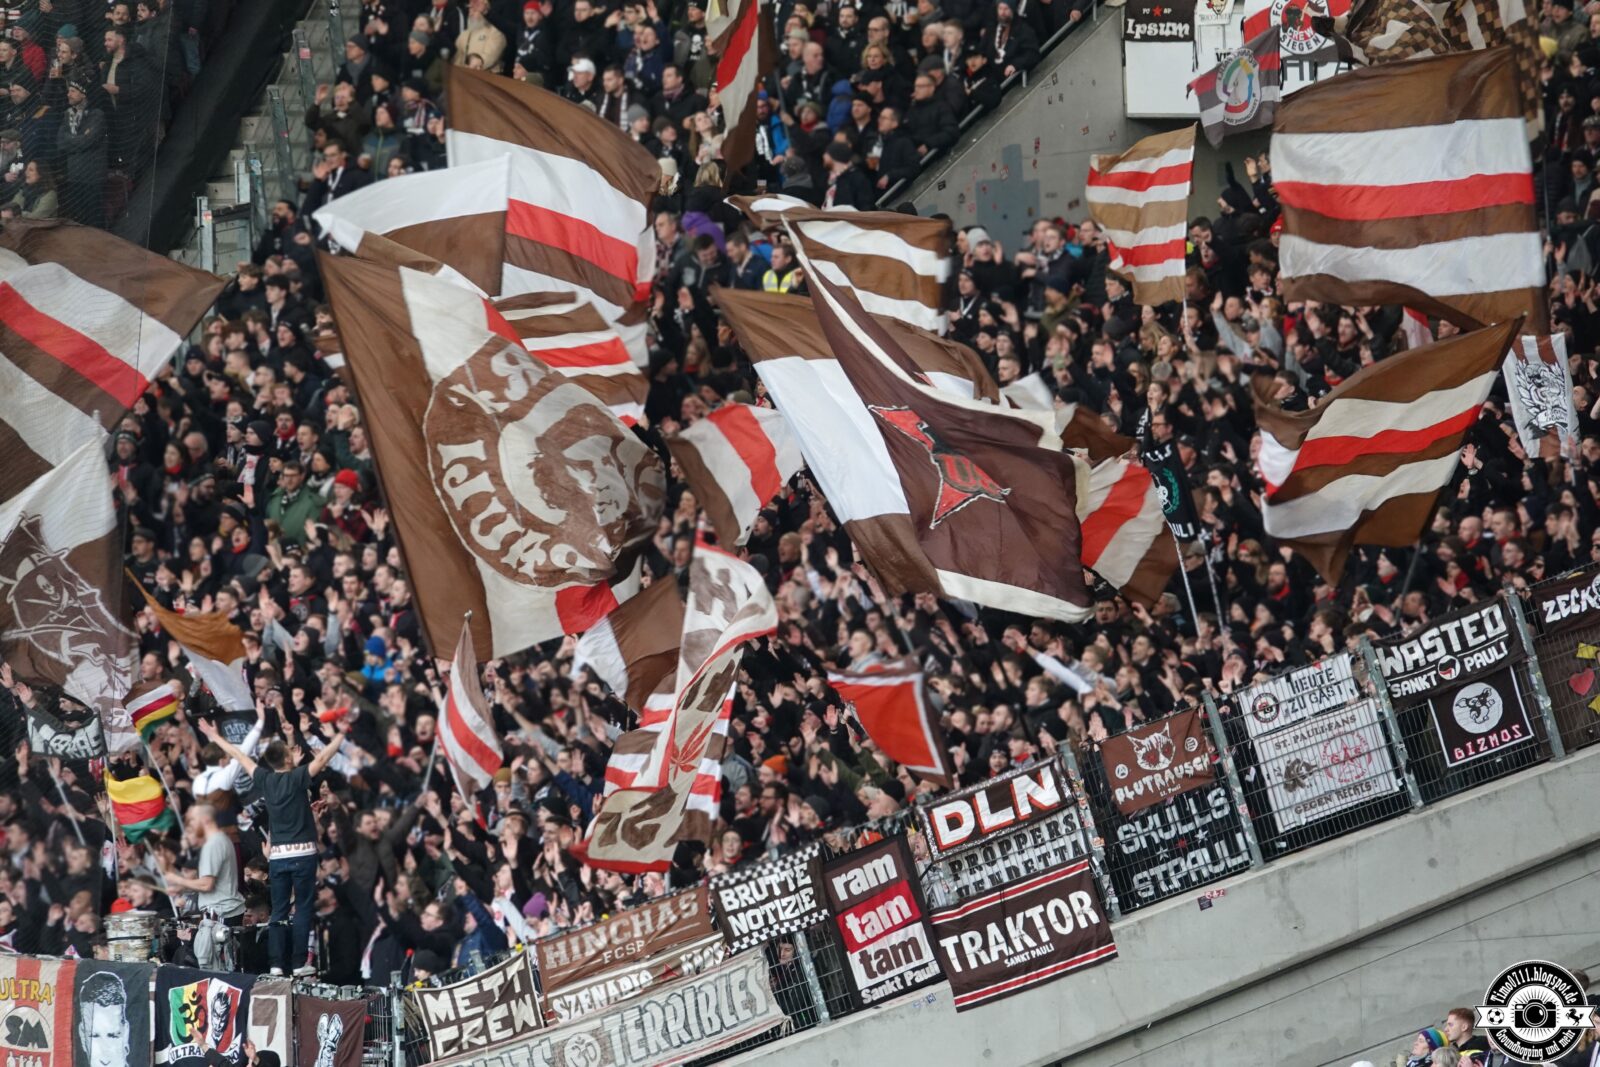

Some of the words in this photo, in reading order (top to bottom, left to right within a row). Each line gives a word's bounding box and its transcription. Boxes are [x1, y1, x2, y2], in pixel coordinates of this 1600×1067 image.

[1126, 18, 1190, 39] Ipsum
[1280, 34, 1321, 52] SIEGEN
[1287, 26, 1315, 41] CREW
[1376, 603, 1507, 677] WASTED
[1290, 667, 1335, 695] HEUTE
[1390, 670, 1438, 699] SANKT
[1464, 643, 1509, 672] PAULI
[1288, 695, 1307, 713] ZU
[1454, 724, 1524, 760] GIZMOS
[1115, 753, 1210, 805] BLUTRAUSCH
[930, 766, 1062, 850] DLN
[1117, 787, 1231, 855] SKULLS
[1294, 794, 1333, 815] GEGEN
[949, 813, 1077, 881] PROPPERS
[718, 862, 812, 912] BRUTTE
[832, 853, 898, 901] ram
[543, 892, 699, 970] HINCHAS
[727, 887, 817, 937] NOTIZIE
[846, 894, 912, 944] tam
[940, 890, 1100, 973] TRAKTOR
[603, 940, 645, 964] FCSP
[859, 935, 923, 980] tam
[1004, 951, 1030, 968] SANKT
[1030, 943, 1055, 961] PAULI
[423, 956, 525, 1026] METT
[861, 975, 902, 1004] Sankt
[904, 962, 940, 987] Pauli
[5, 1015, 49, 1048] SM
[433, 993, 538, 1058] CREW
[601, 956, 770, 1066] TERRIBLES
[168, 1045, 205, 1062] ULTRA
